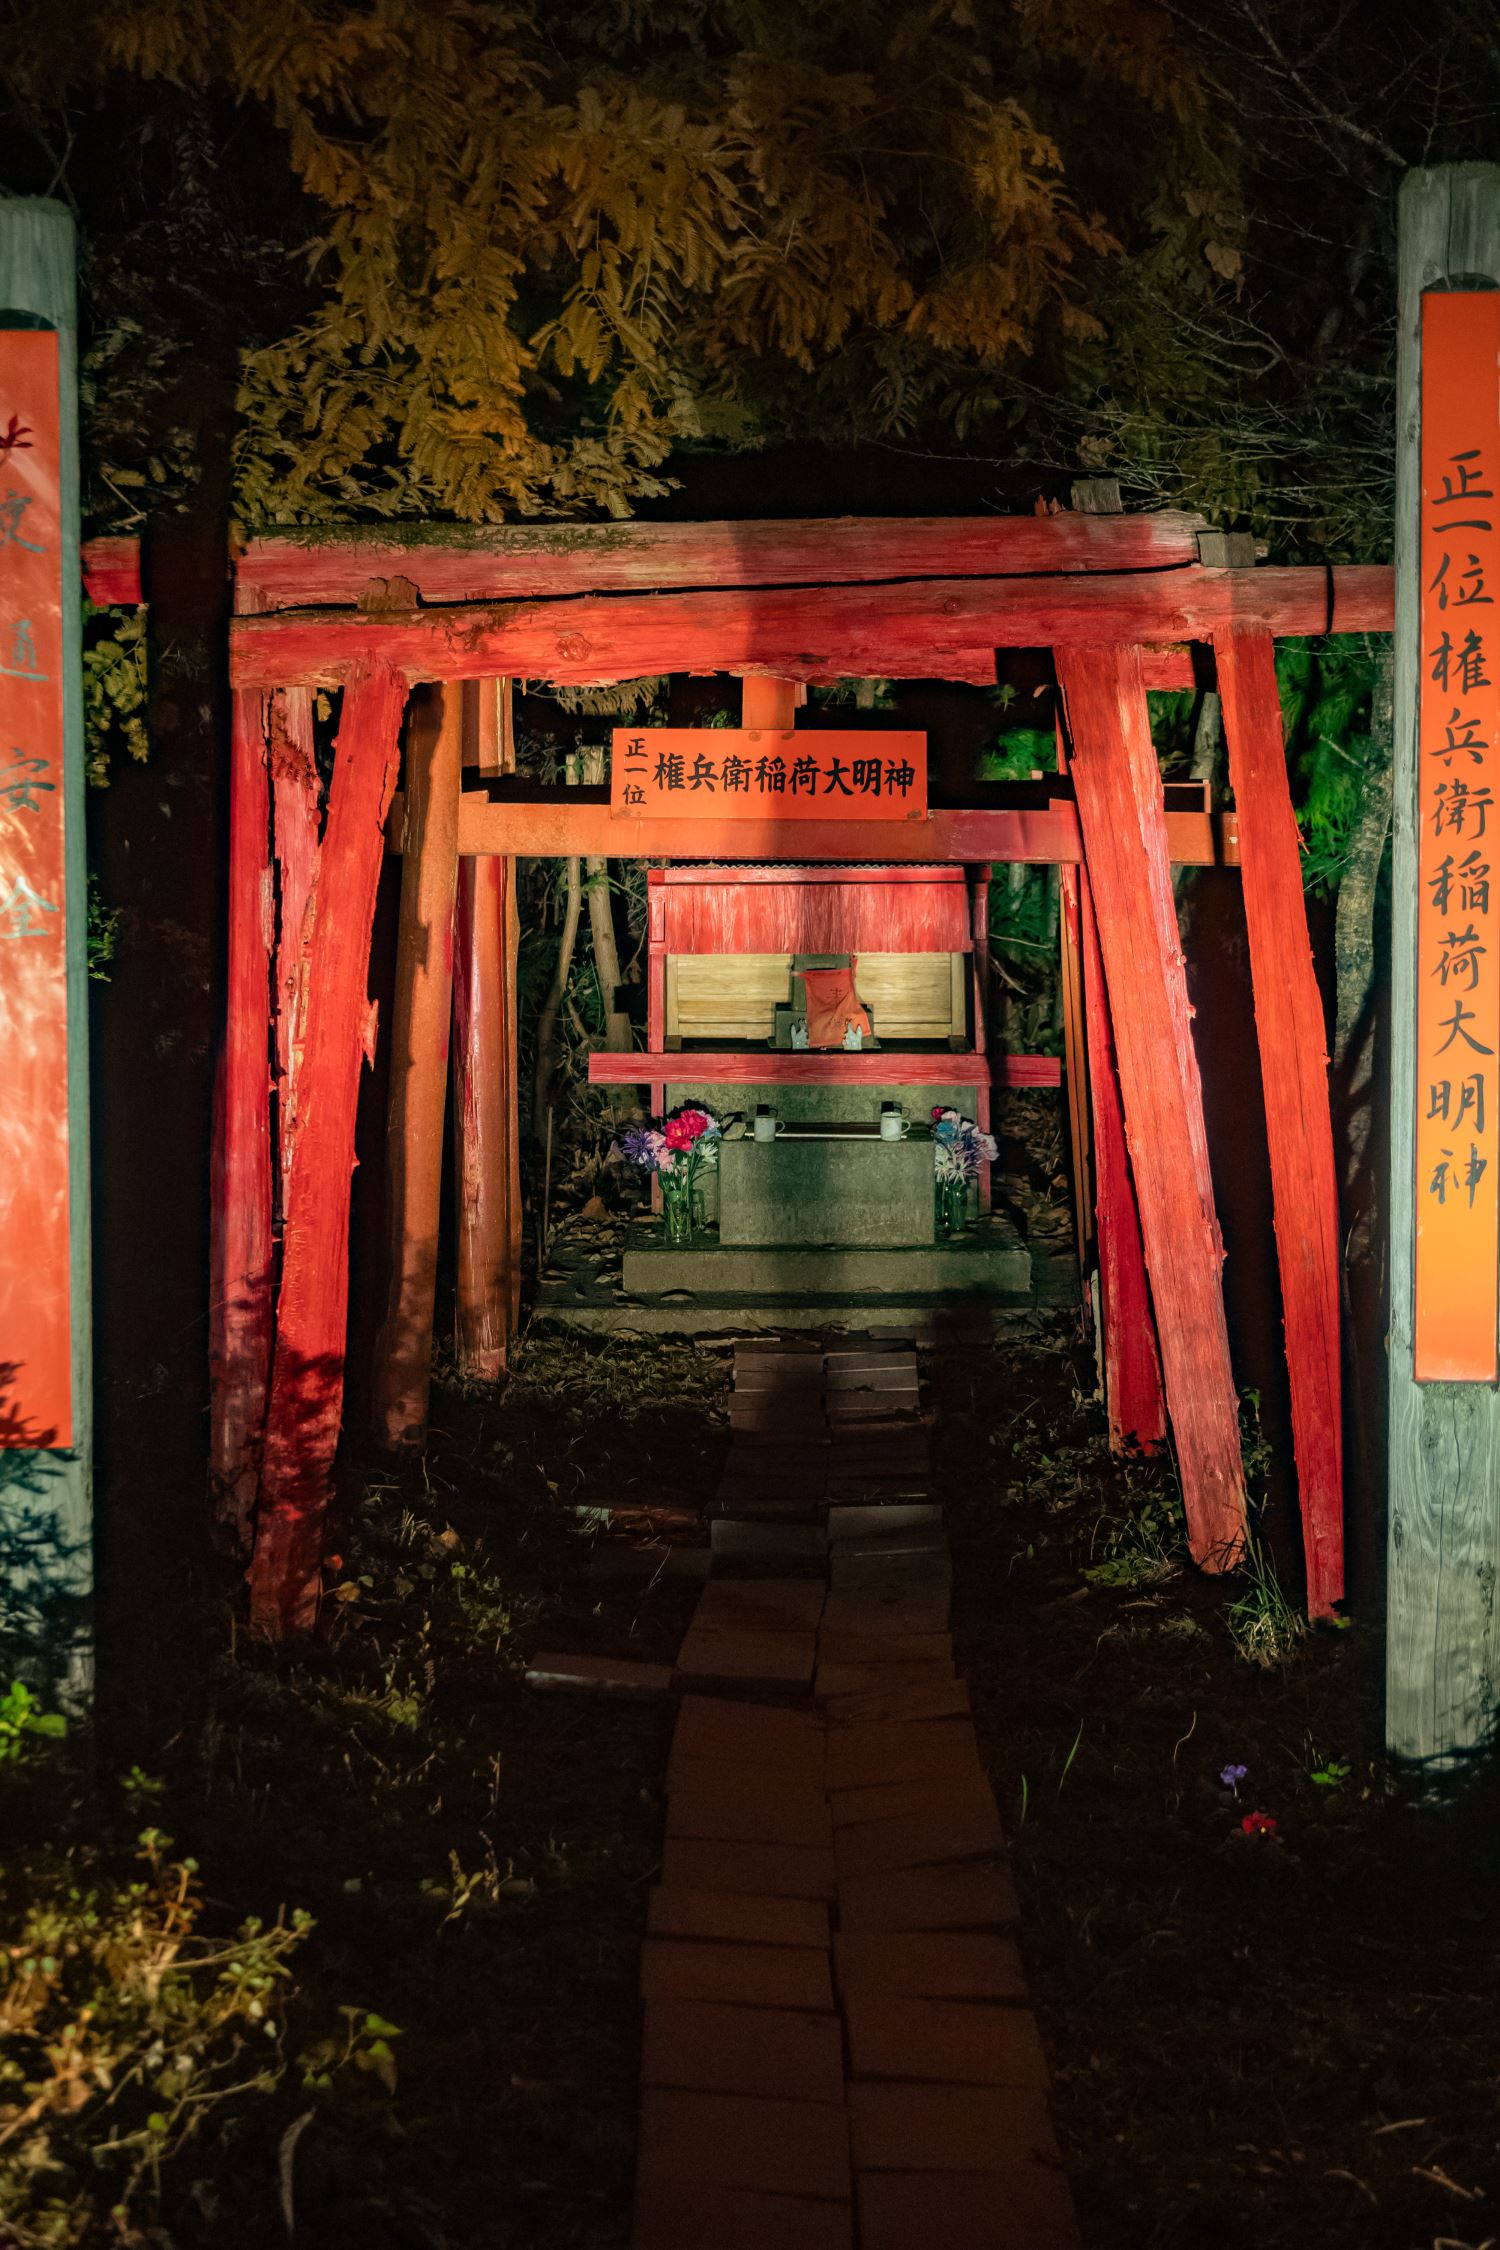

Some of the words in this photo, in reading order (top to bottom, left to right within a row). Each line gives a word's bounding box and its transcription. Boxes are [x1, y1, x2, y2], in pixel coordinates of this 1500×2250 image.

[621, 737, 649, 806] 正一位
[652, 751, 916, 798] 権兵衛稲荷大明神
[1426, 449, 1495, 1209] 正一位権兵衛稲荷大明神
